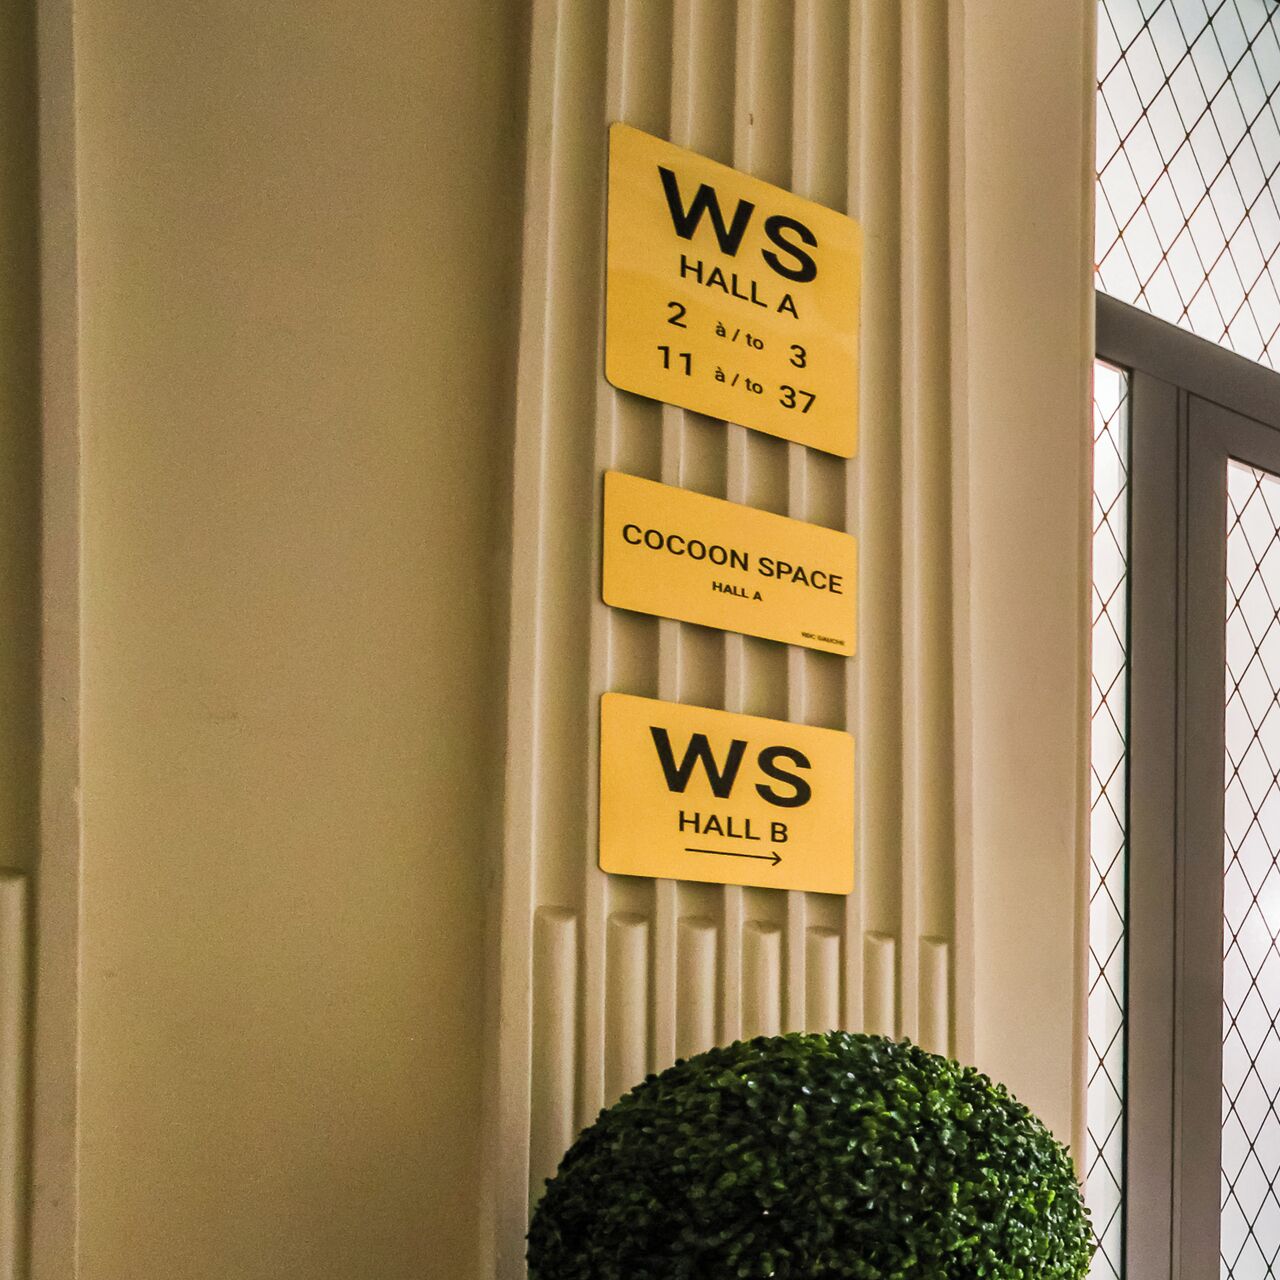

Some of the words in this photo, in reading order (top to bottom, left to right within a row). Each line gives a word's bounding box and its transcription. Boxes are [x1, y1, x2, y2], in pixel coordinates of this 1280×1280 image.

[657, 165, 818, 283] WS
[680, 254, 768, 308] HALL
[776, 293, 800, 319] A
[667, 301, 687, 328] 2
[715, 322, 726, 337] à
[745, 333, 764, 350] to
[789, 344, 807, 369] 3
[657, 346, 692, 376] 11
[714, 367, 726, 382] à
[745, 377, 763, 395] to
[779, 385, 816, 414] 37
[622, 524, 749, 572] COCOON
[758, 557, 844, 594] SPACE
[711, 580, 749, 599] HALL
[752, 590, 763, 602] A
[649, 726, 812, 808] WS
[678, 810, 761, 840] HALL
[770, 821, 789, 843] B
